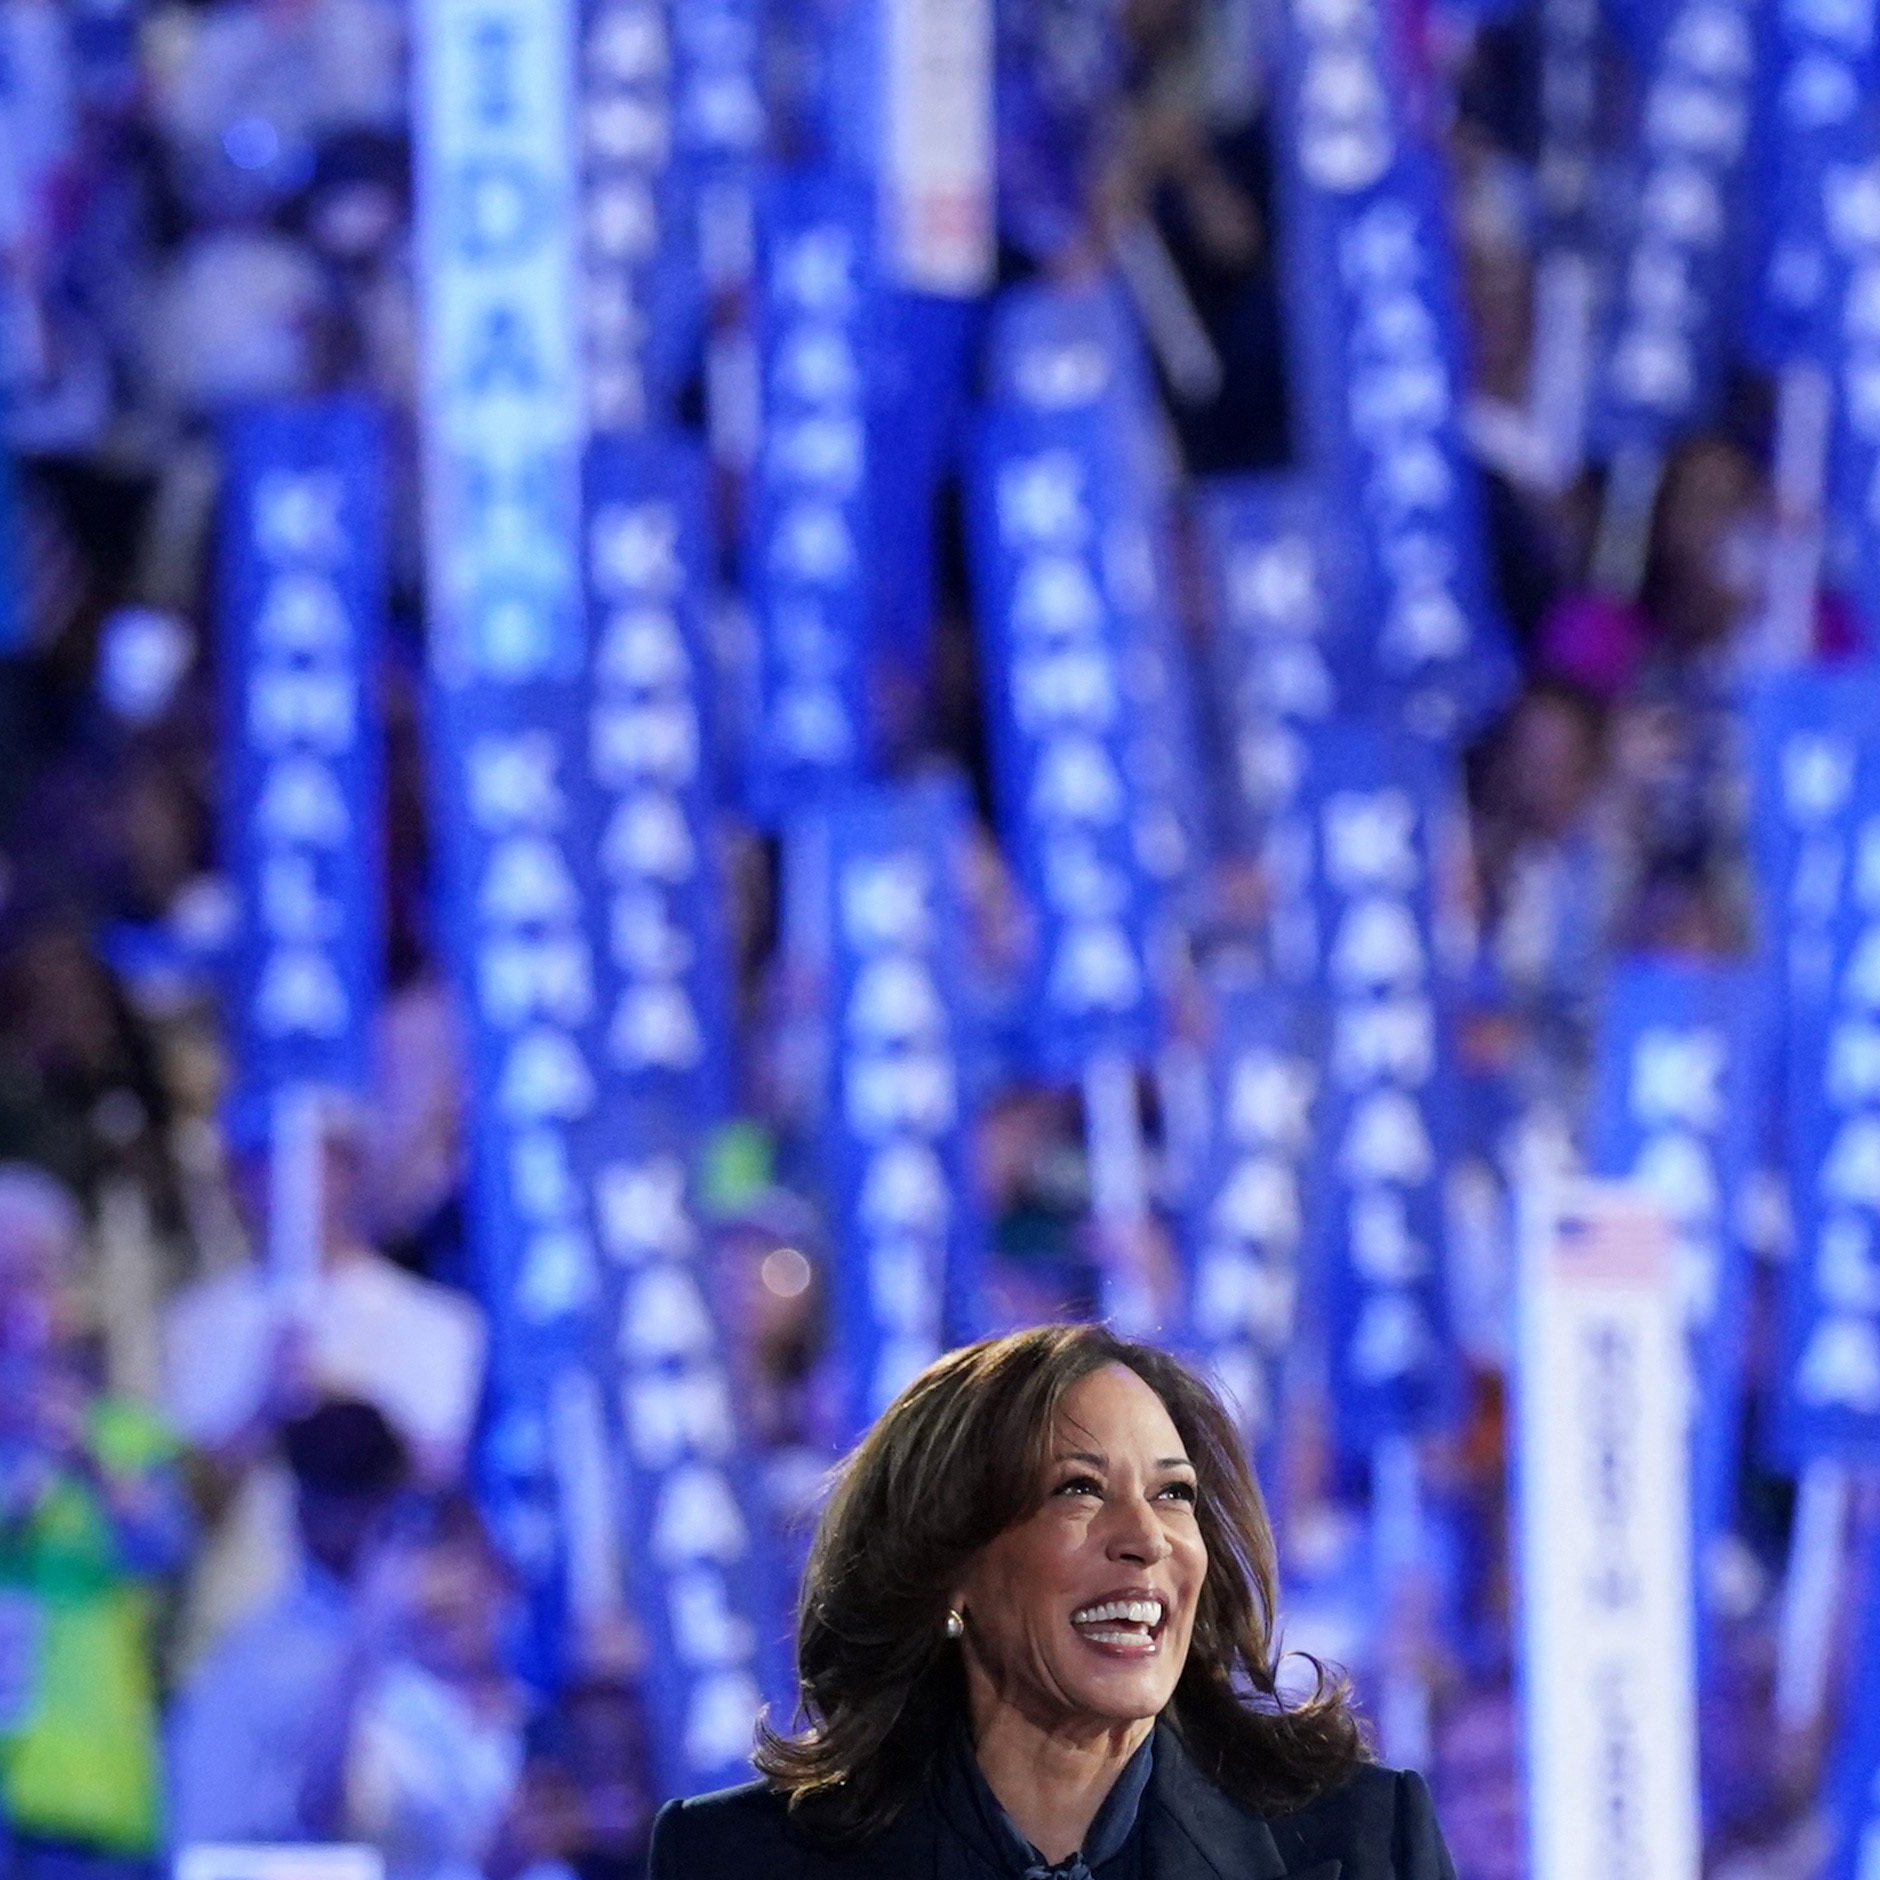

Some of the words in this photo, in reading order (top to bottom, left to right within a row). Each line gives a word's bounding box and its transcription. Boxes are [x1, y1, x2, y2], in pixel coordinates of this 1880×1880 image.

[249, 470, 358, 1035] KAMALA
[591, 503, 702, 1072] KAMALA
[997, 450, 1138, 1008] KAMALA
[1324, 790, 1432, 1378] KAMALA
[596, 1160, 760, 1765] KAMALA
